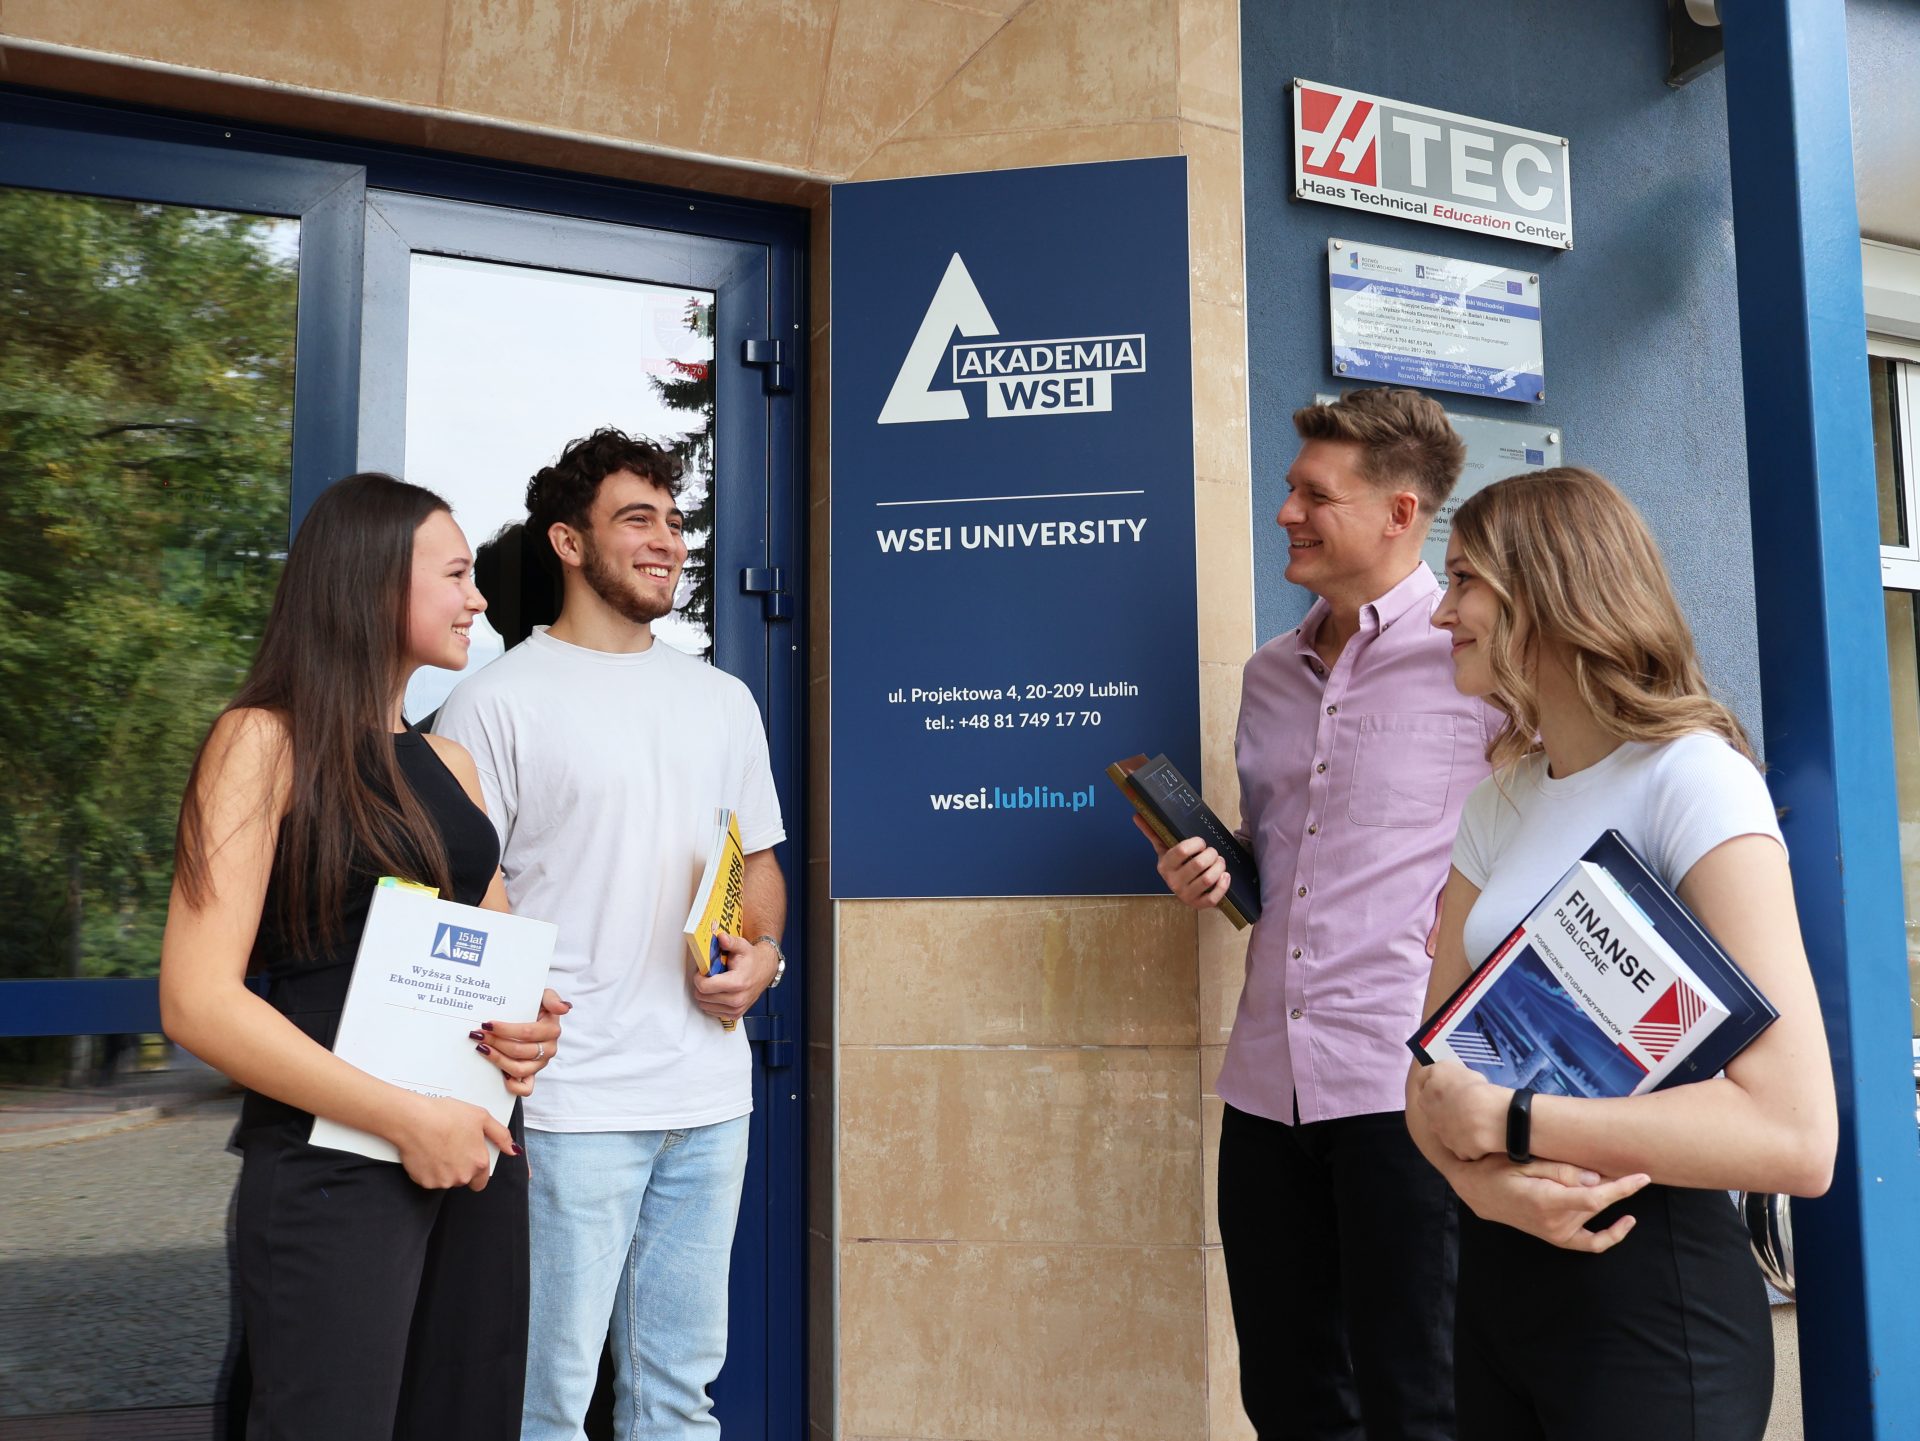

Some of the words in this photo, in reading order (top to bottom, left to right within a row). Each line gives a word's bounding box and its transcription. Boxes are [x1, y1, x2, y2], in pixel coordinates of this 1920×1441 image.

[1302, 178, 1346, 199] Haas
[1350, 188, 1428, 214] Technical
[1433, 204, 1511, 231] Education
[1515, 221, 1567, 242] Center
[960, 341, 1138, 376] AKADEMIA
[998, 377, 1095, 411] WSEI
[876, 526, 951, 552] WSEI
[960, 518, 1147, 549] UNIVERSITY
[888, 688, 907, 703] ul.
[911, 687, 1002, 704] Projektowa
[1006, 685, 1022, 702] 4,
[1025, 683, 1085, 699] 20-209
[1089, 682, 1139, 698] Lublin
[925, 715, 954, 730] tel.:
[958, 714, 990, 728] +48
[994, 714, 1015, 728] 81
[1019, 713, 1050, 728] 749
[1055, 712, 1076, 727] 17
[1080, 711, 1101, 726] 70
[930, 785, 1095, 811] wsei.lublin.pl
[718, 851, 738, 932] TURNING
[458, 931, 470, 942] 15
[470, 933, 483, 945] lat
[1554, 908, 1609, 975] PUBLICZNE
[1565, 889, 1655, 994] FINANSE
[452, 947, 480, 962] WSEI
[389, 973, 443, 992] Ekonomii
[446, 985, 450, 993] i
[453, 986, 506, 1005] Innowacji
[412, 965, 451, 981] Wyższa
[455, 974, 491, 989] Szkoła
[1563, 971, 1584, 996] STUDIA
[417, 993, 426, 1001] w
[429, 994, 474, 1010] Lublinie
